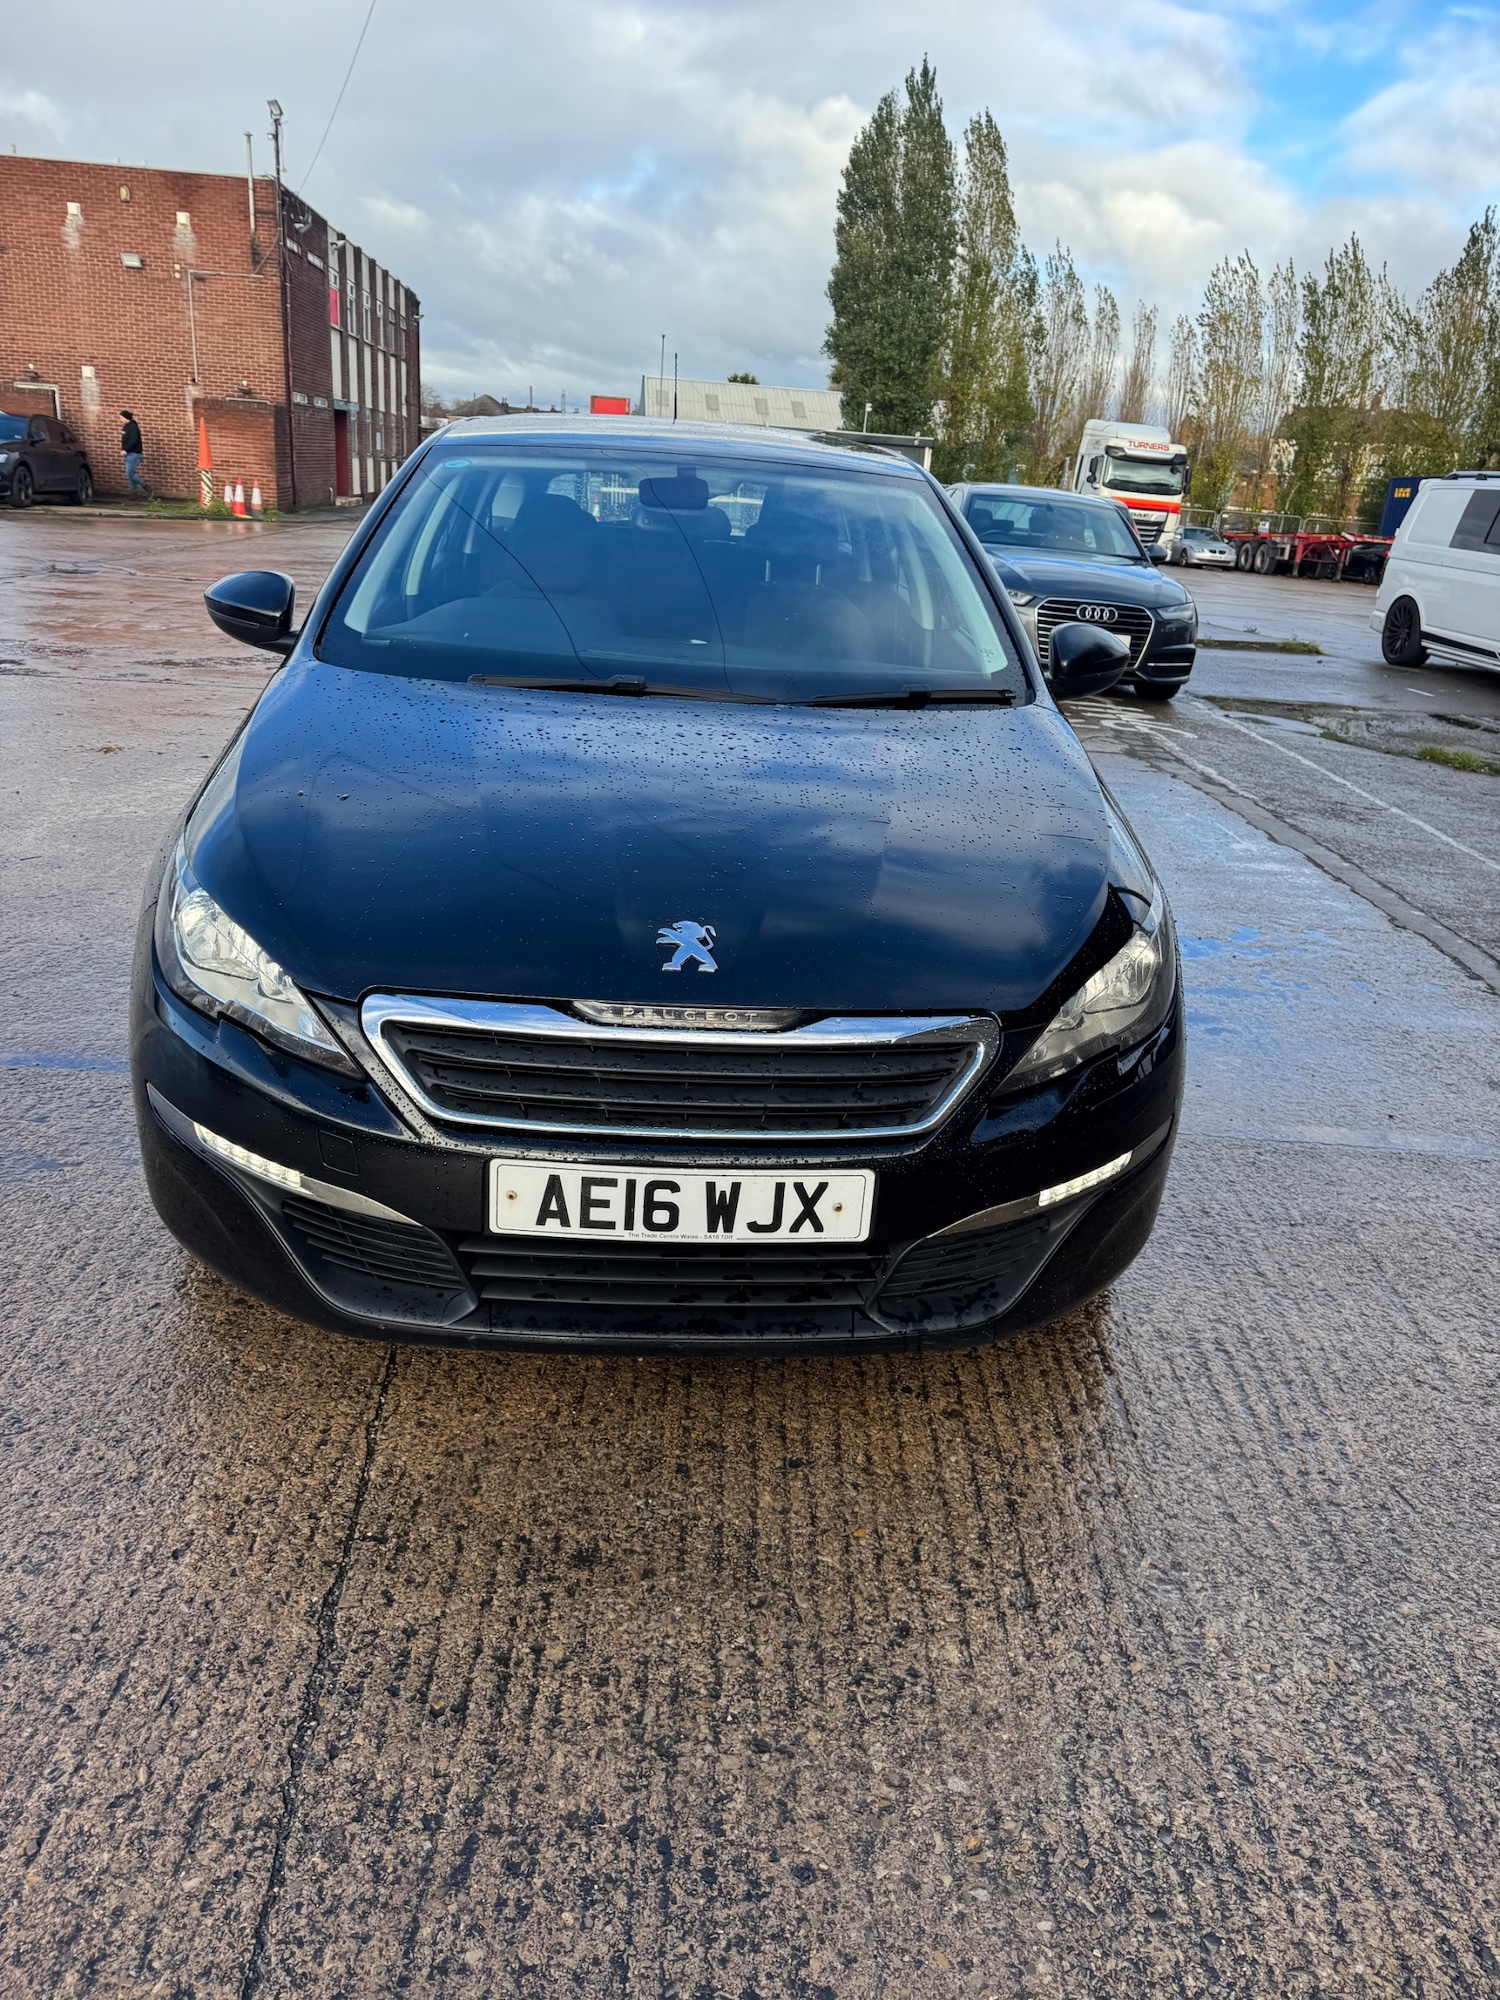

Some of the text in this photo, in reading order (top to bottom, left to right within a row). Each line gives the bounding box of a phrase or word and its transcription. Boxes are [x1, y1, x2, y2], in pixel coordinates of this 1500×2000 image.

[1128, 440, 1169, 452] TURNERS
[623, 1007, 757, 1022] PEUGEOT
[535, 1174, 829, 1233] AE16 WJX
